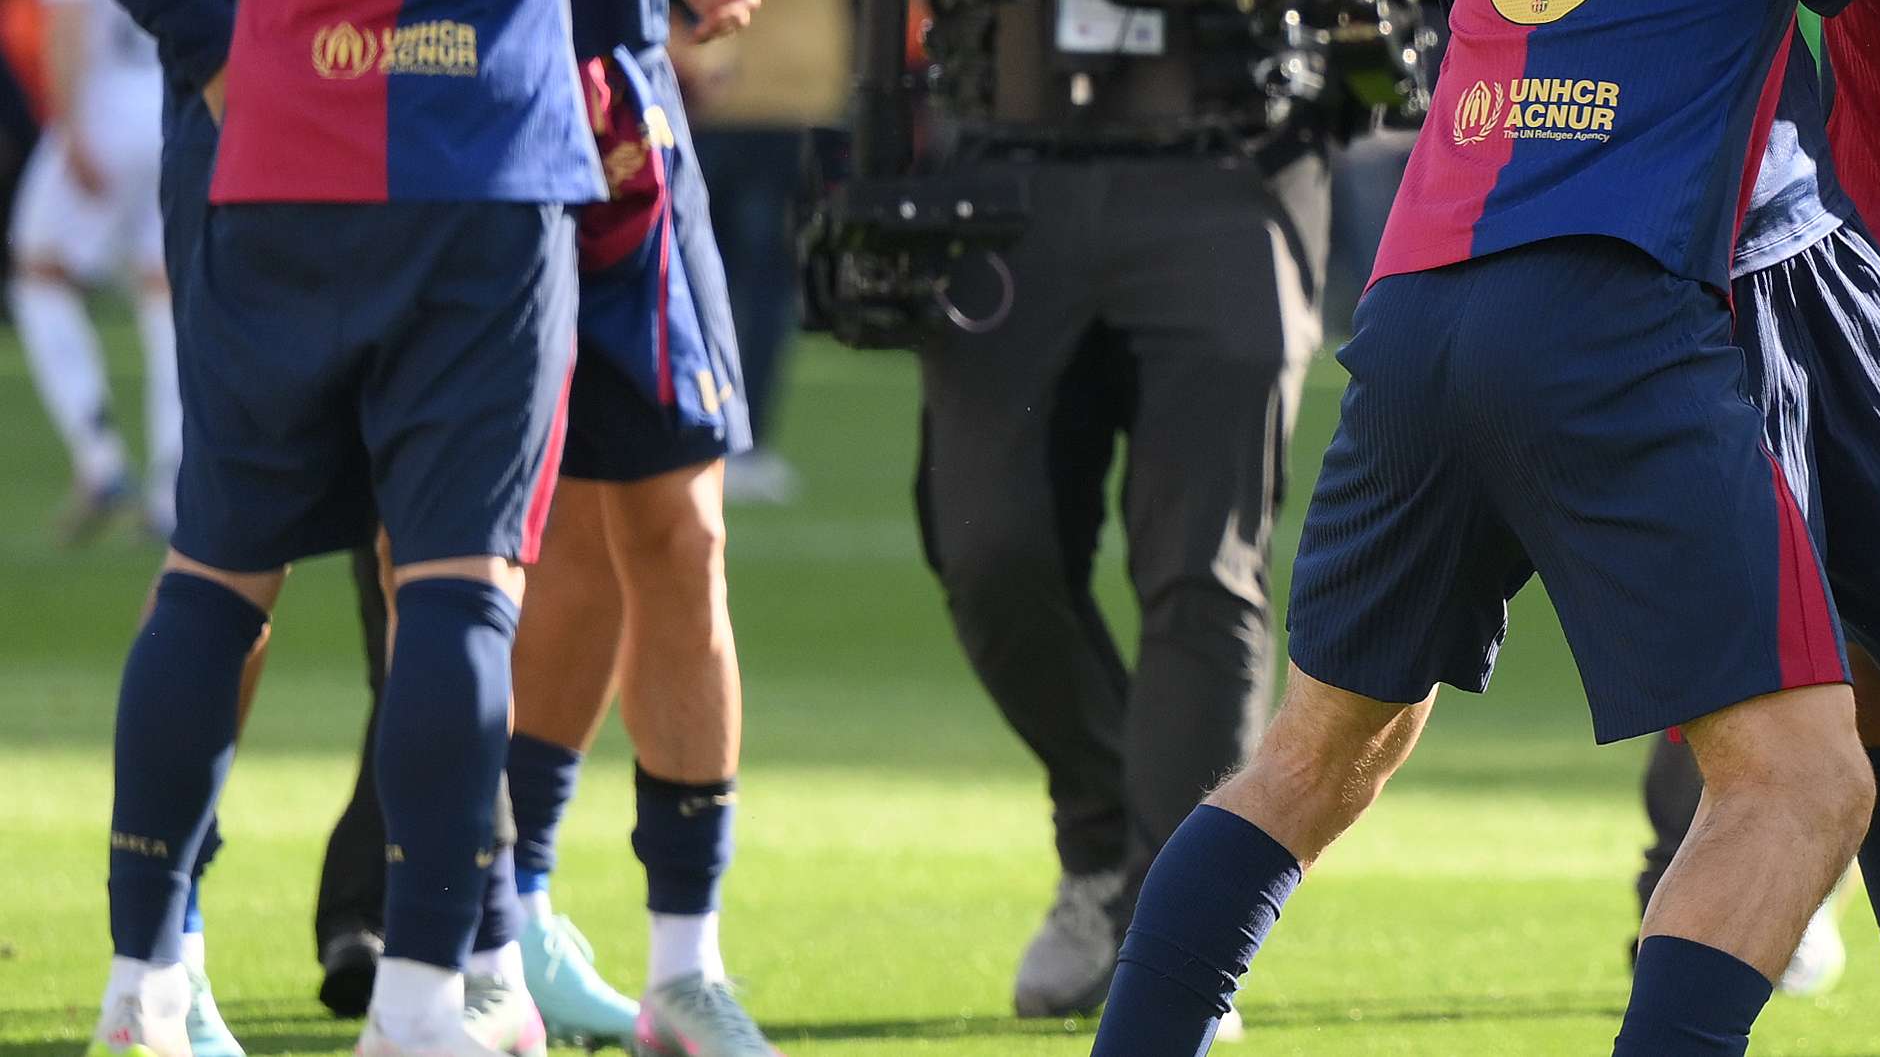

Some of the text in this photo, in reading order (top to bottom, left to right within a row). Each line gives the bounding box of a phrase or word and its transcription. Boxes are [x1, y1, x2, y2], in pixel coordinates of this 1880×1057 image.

[1509, 78, 1620, 108] UNHCR
[1504, 103, 1616, 132] ACNUR
[1503, 129, 1610, 143] The UN Refugee Agency
